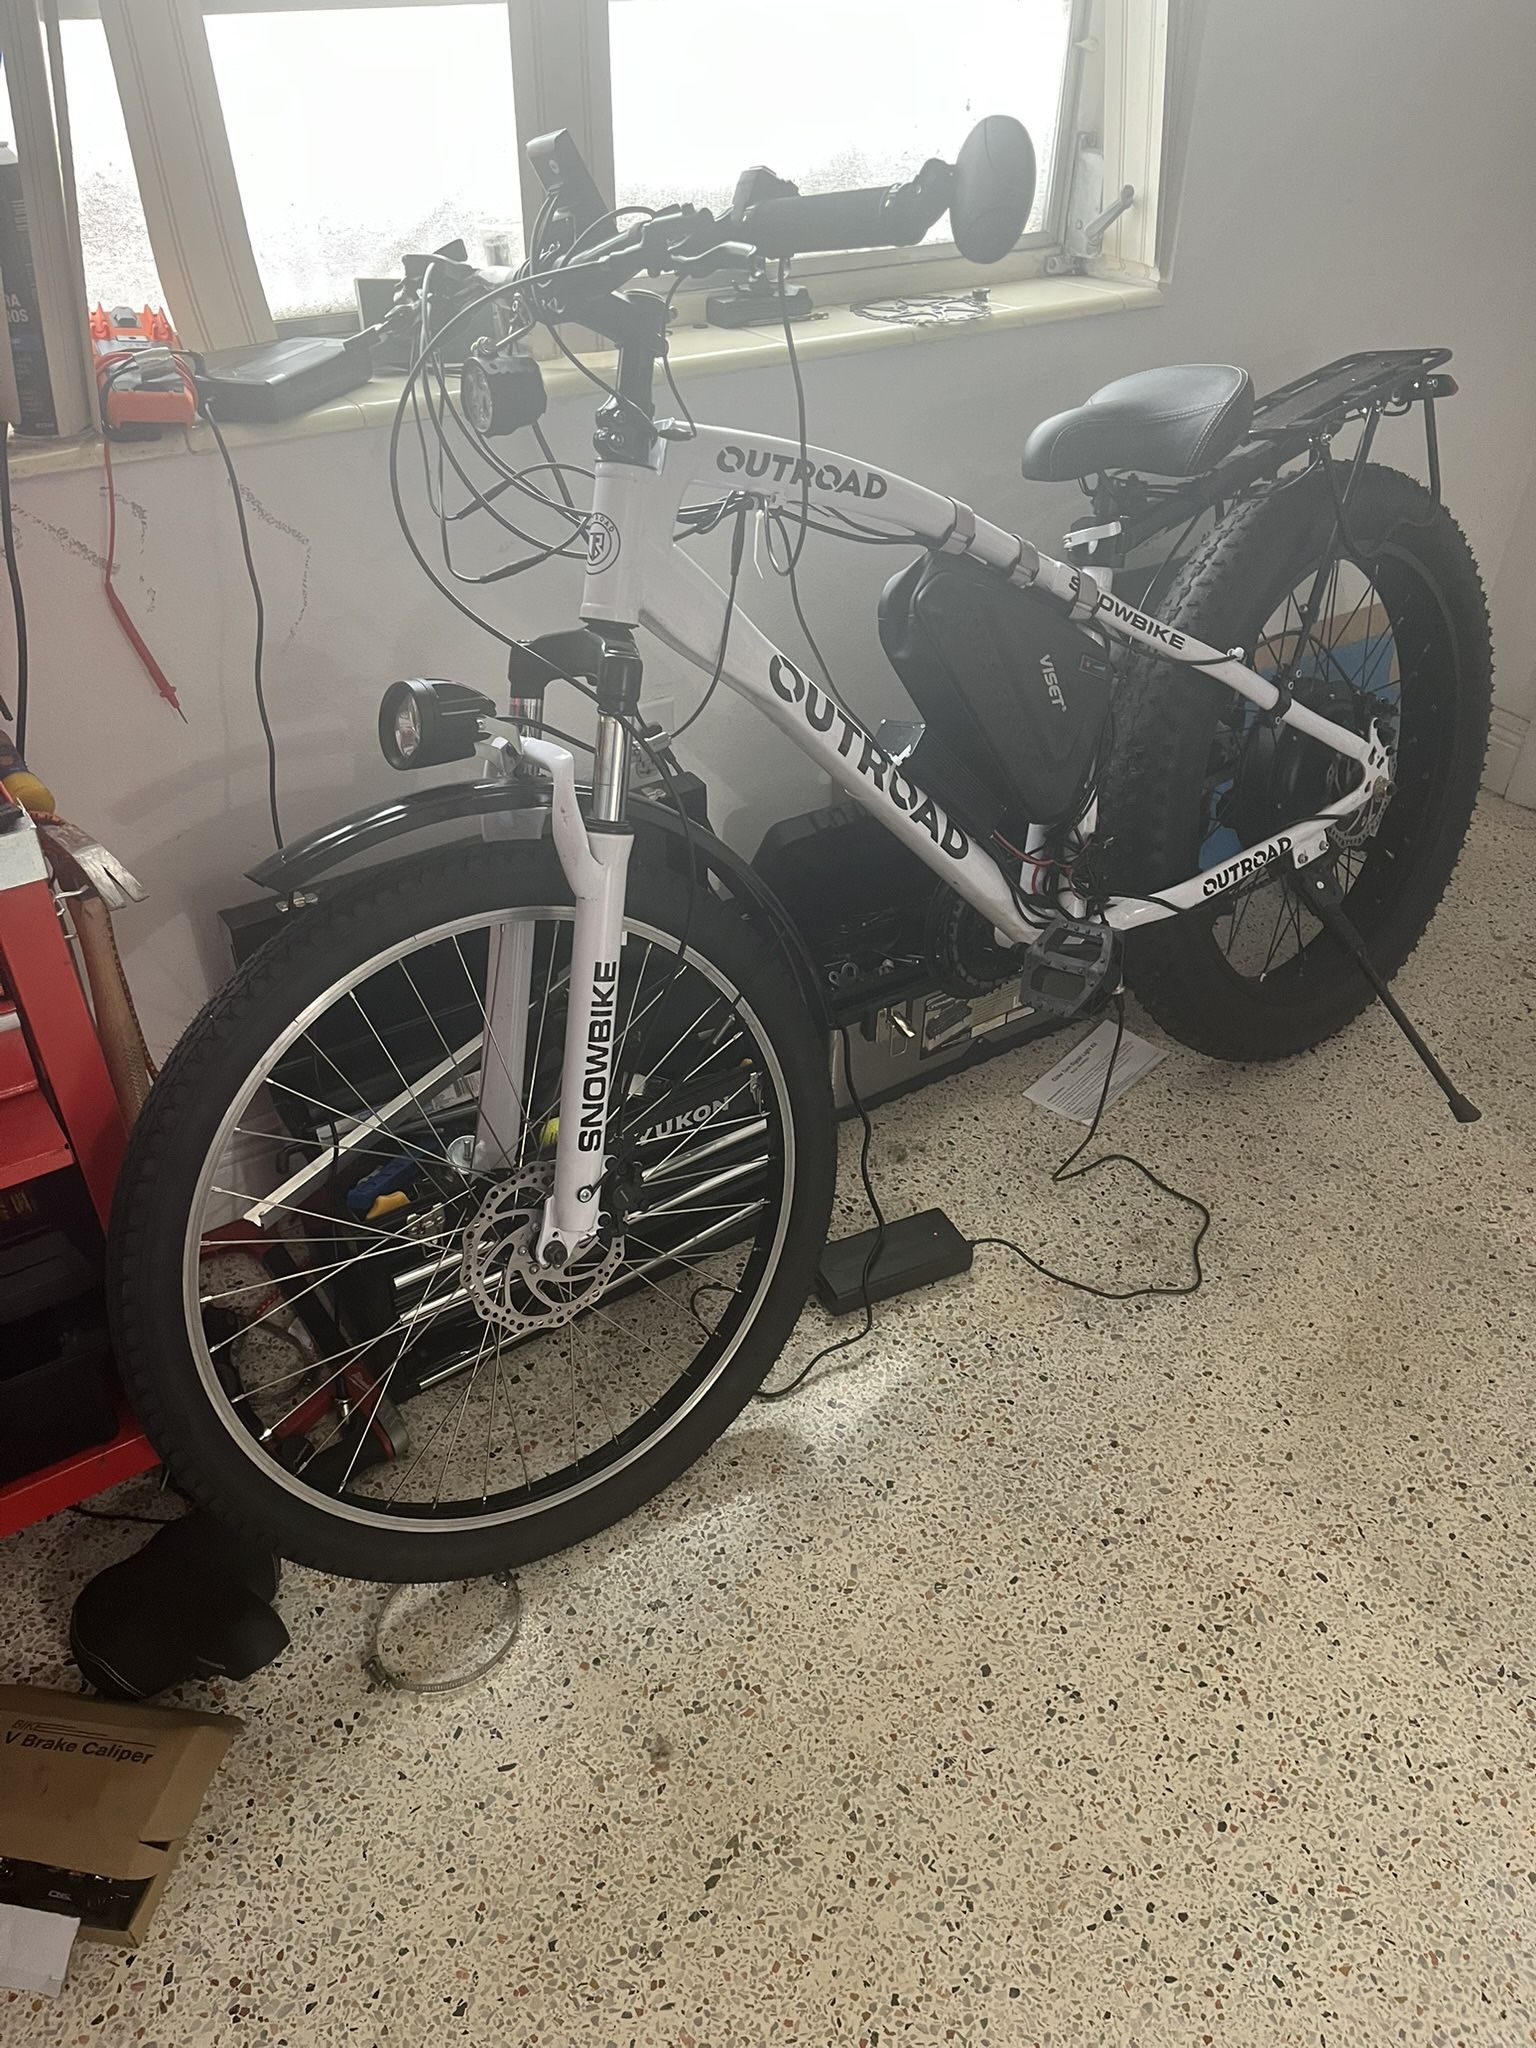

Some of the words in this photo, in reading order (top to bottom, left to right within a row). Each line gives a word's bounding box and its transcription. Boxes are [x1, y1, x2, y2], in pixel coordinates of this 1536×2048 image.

[716, 446, 888, 499] OUTROAD
[1069, 575, 1186, 650] SOWBIKE
[1040, 654, 1066, 707] VISET
[769, 654, 969, 860] OUTROAD
[1203, 837, 1292, 897] OUTROAD
[578, 961, 617, 1152] SNOWBIKE
[5, 1731, 21, 1744] V
[21, 1733, 78, 1752] Brake
[81, 1741, 154, 1765] Caliper
